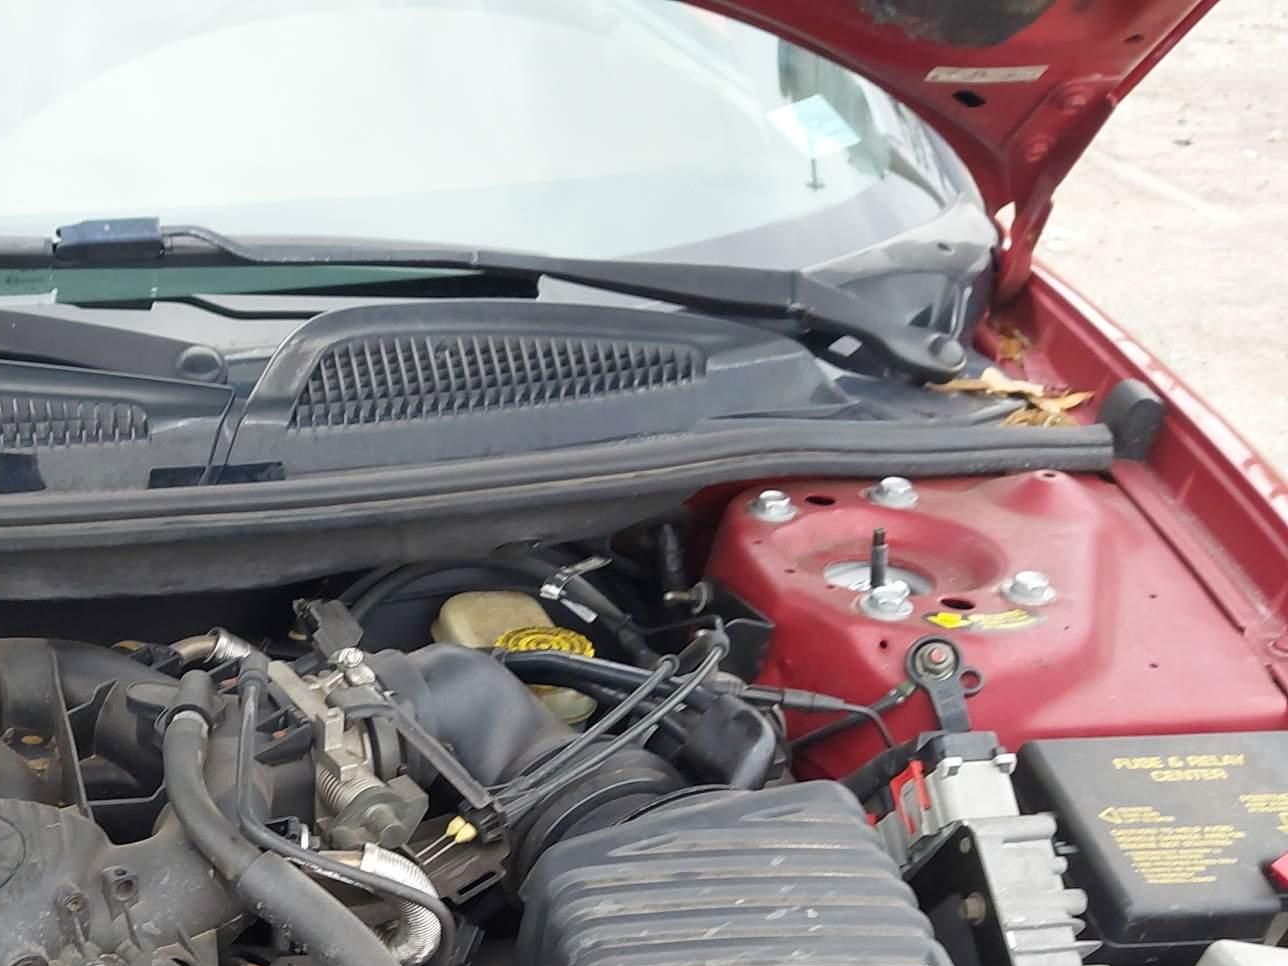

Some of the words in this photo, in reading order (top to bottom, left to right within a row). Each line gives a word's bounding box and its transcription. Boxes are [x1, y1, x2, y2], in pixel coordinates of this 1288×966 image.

[1112, 756, 1164, 769] FUSE
[1167, 755, 1184, 768] &
[1186, 753, 1245, 767] RELAY
[1150, 768, 1229, 782] CENTER
